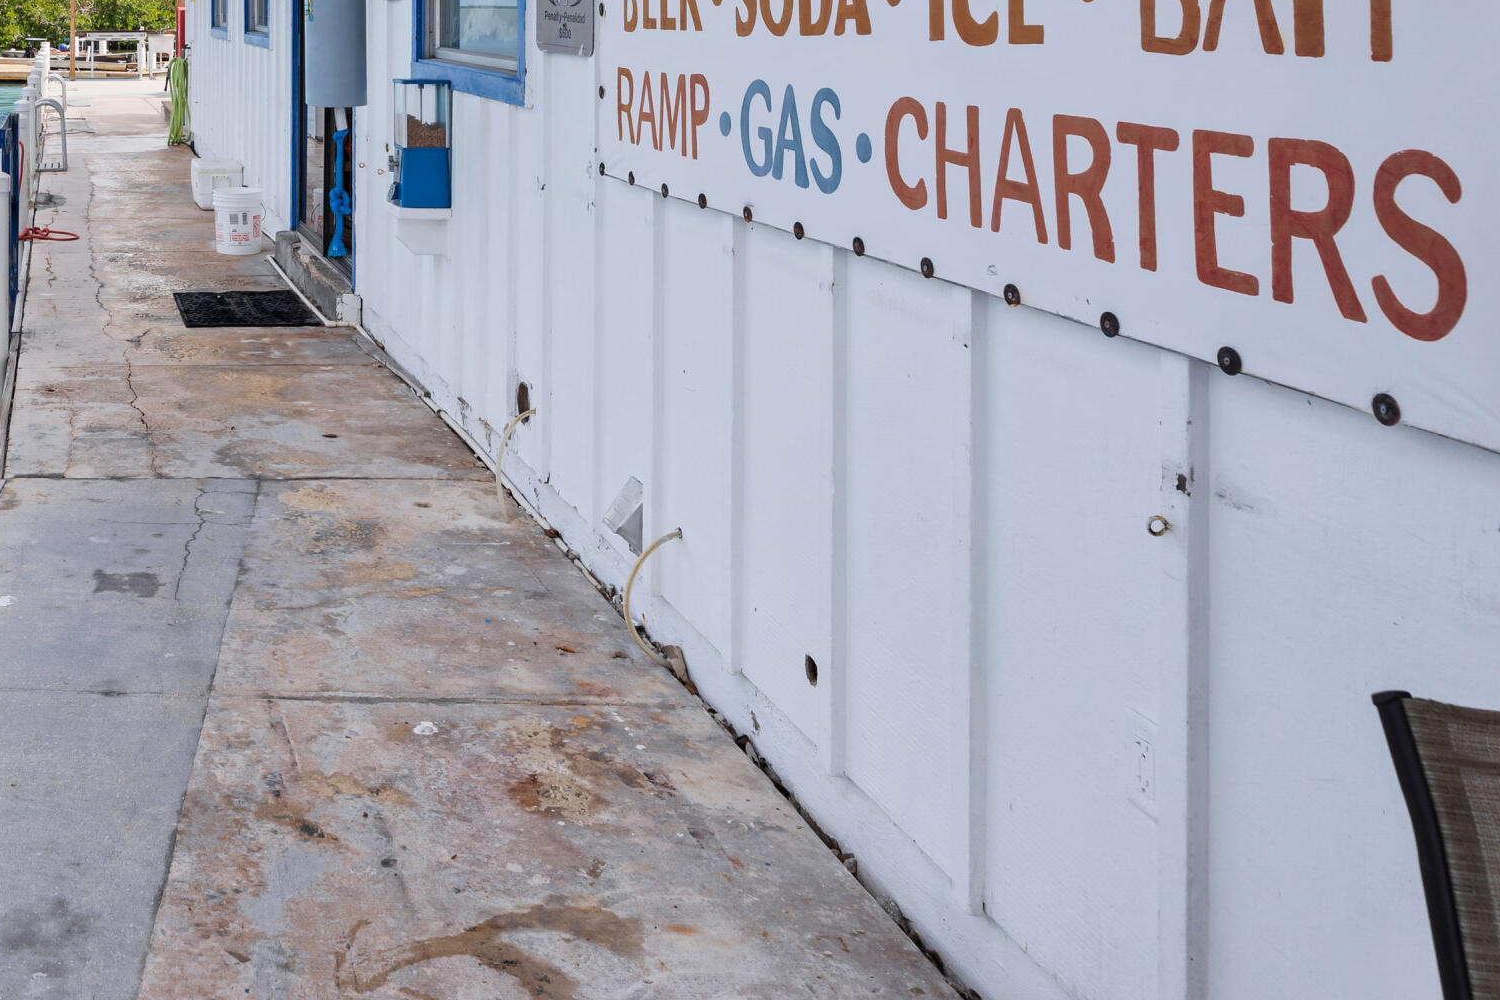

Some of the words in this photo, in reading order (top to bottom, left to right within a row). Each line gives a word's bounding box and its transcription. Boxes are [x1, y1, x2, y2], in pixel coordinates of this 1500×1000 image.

[616, 67, 711, 160] RAMP
[740, 78, 842, 195] GAS
[884, 96, 1468, 342] CHARTERS
